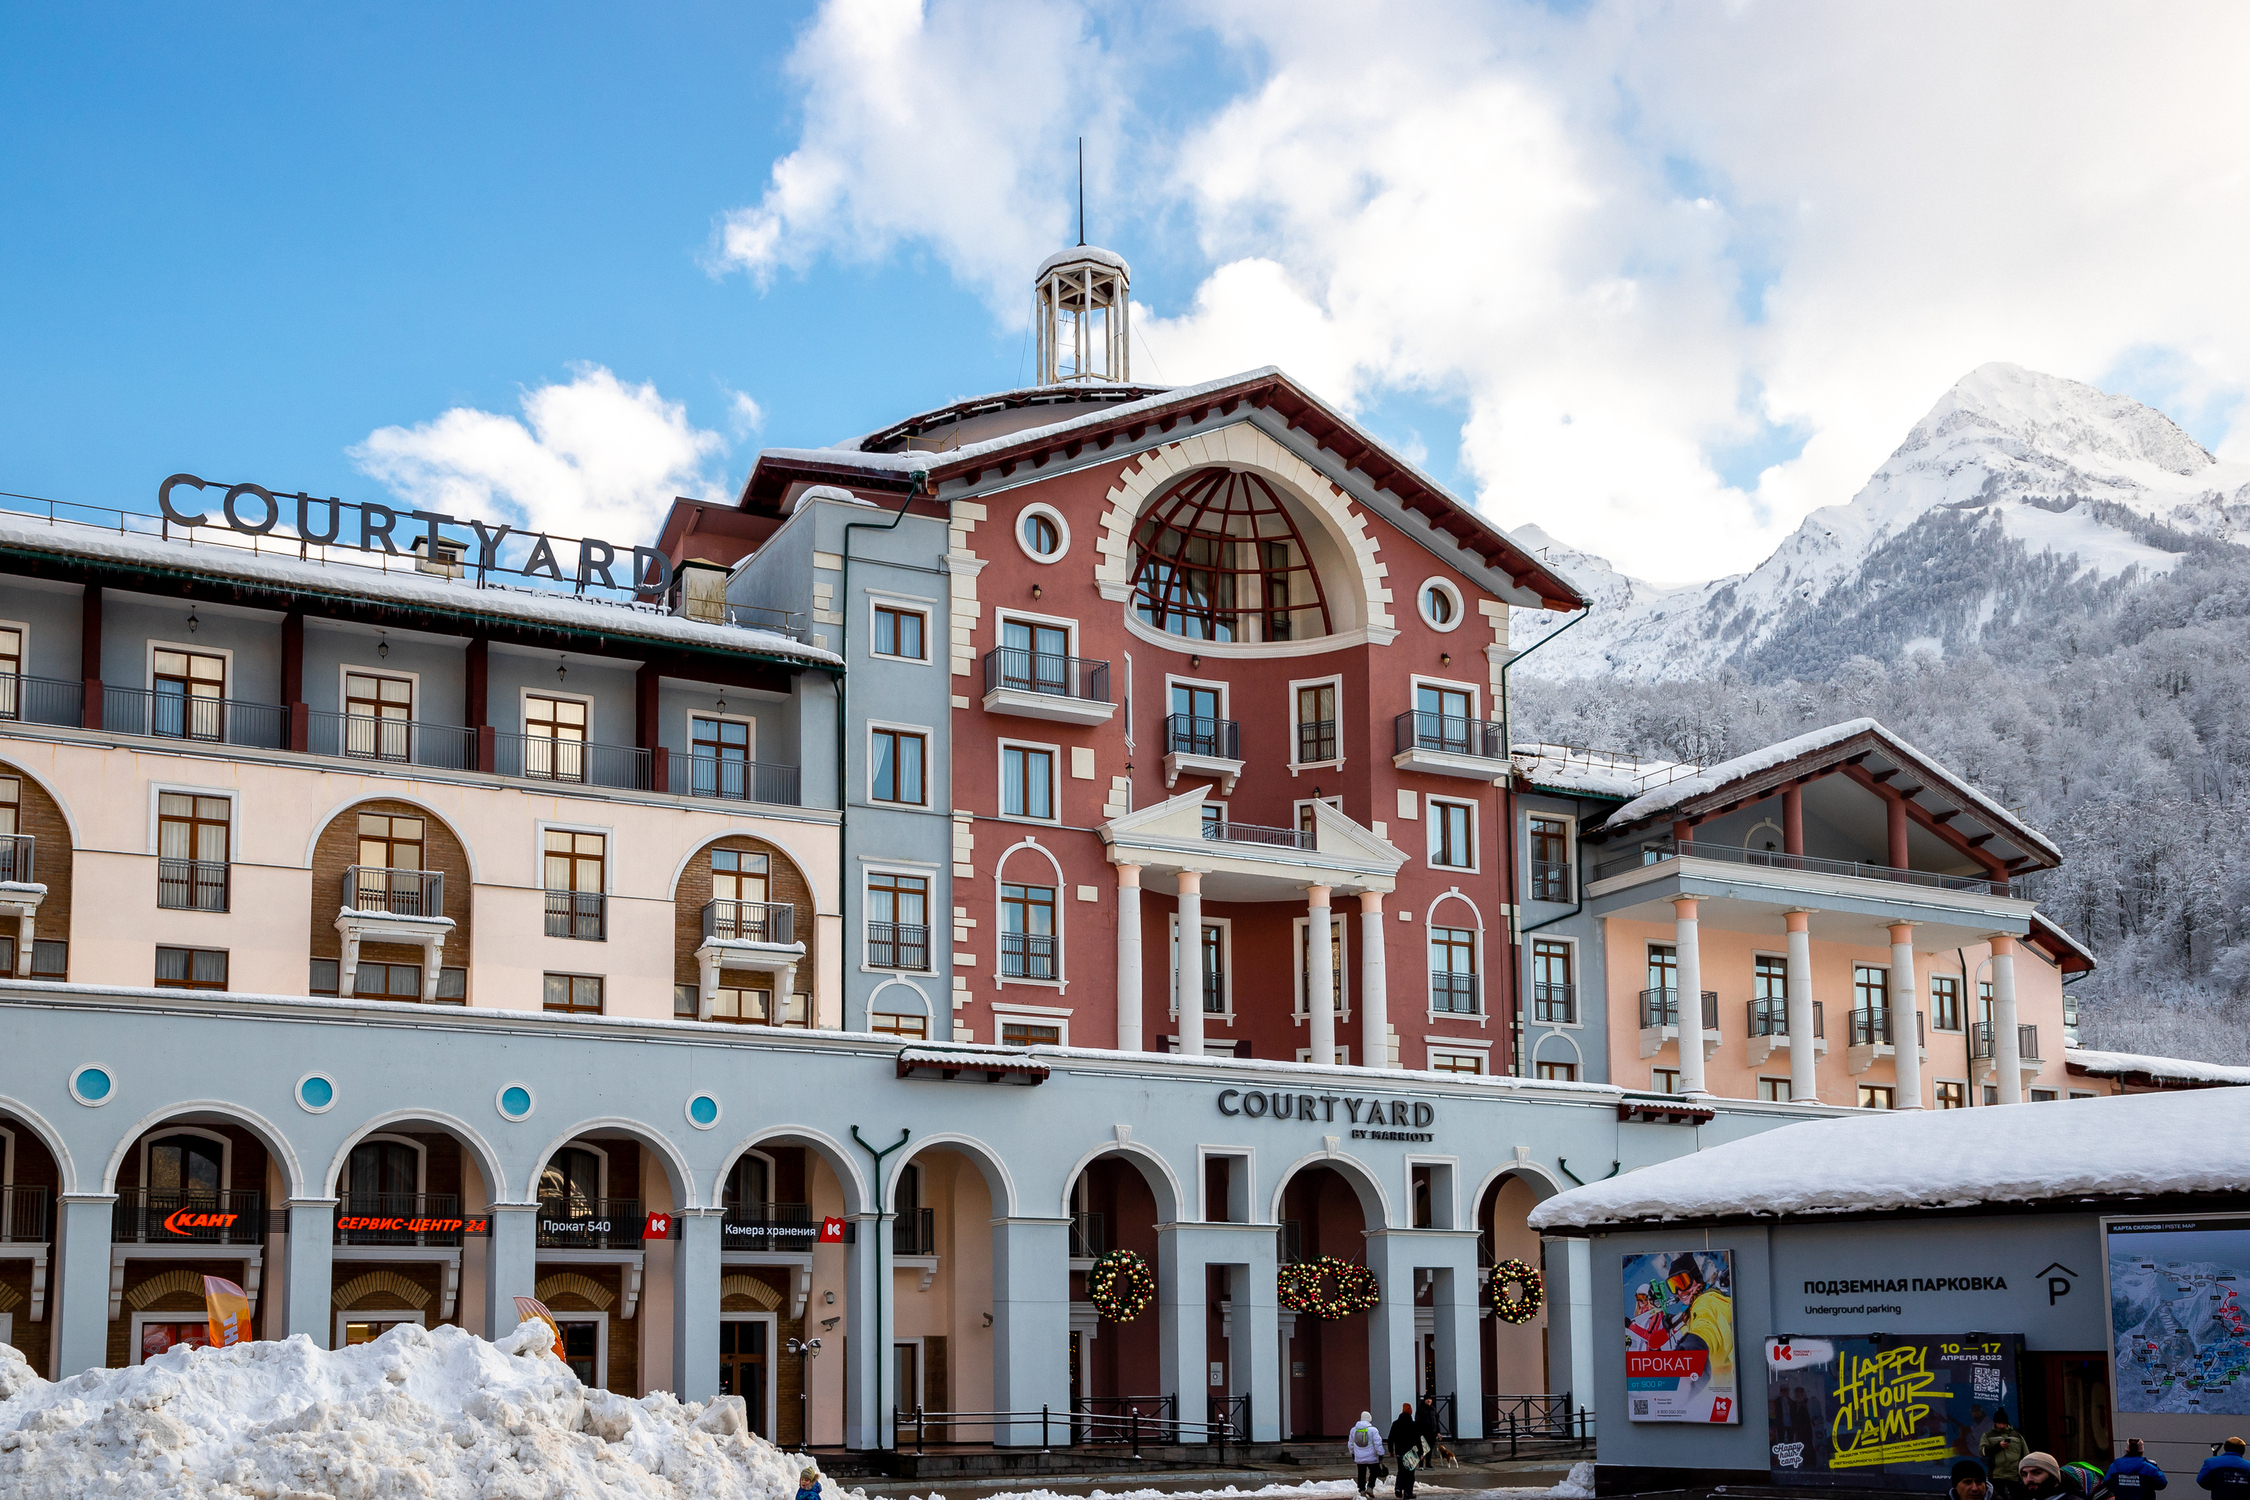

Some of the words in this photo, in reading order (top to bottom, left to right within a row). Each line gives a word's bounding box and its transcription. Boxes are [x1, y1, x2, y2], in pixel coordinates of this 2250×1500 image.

[159, 473, 674, 595] COURTYARD
[1218, 1089, 1434, 1128] COURTYARD
[1352, 1129, 1368, 1140] BY
[1372, 1131, 1434, 1142] MARRIOTT
[176, 1213, 238, 1227] КАНТ
[337, 1217, 462, 1233] СЕРВИС-ЦЕНТР
[465, 1219, 487, 1232] 24
[543, 1220, 585, 1234] Прокат
[587, 1221, 611, 1232] 540
[725, 1224, 764, 1237] Камера
[766, 1227, 816, 1238] хранения
[1804, 1279, 1908, 1296] ПОДЗЕМНАЯ
[1912, 1277, 2008, 1292] ПАРКОВКА
[1805, 1305, 1864, 1316] Underground
[1867, 1304, 1902, 1315] parking
[1940, 1343, 1960, 1354] 10
[1981, 1342, 2002, 1354] 17
[1631, 1357, 1693, 1372] ПРОКАТ
[1641, 1380, 1656, 1388] 900
[1833, 1346, 1928, 1411] HAPPY
[1859, 1371, 1954, 1418] HOUR
[1832, 1402, 1930, 1454] CAMP
[1773, 1443, 1803, 1453] Happy
[1779, 1450, 1799, 1459] hour
[1781, 1456, 1802, 1467] camp
